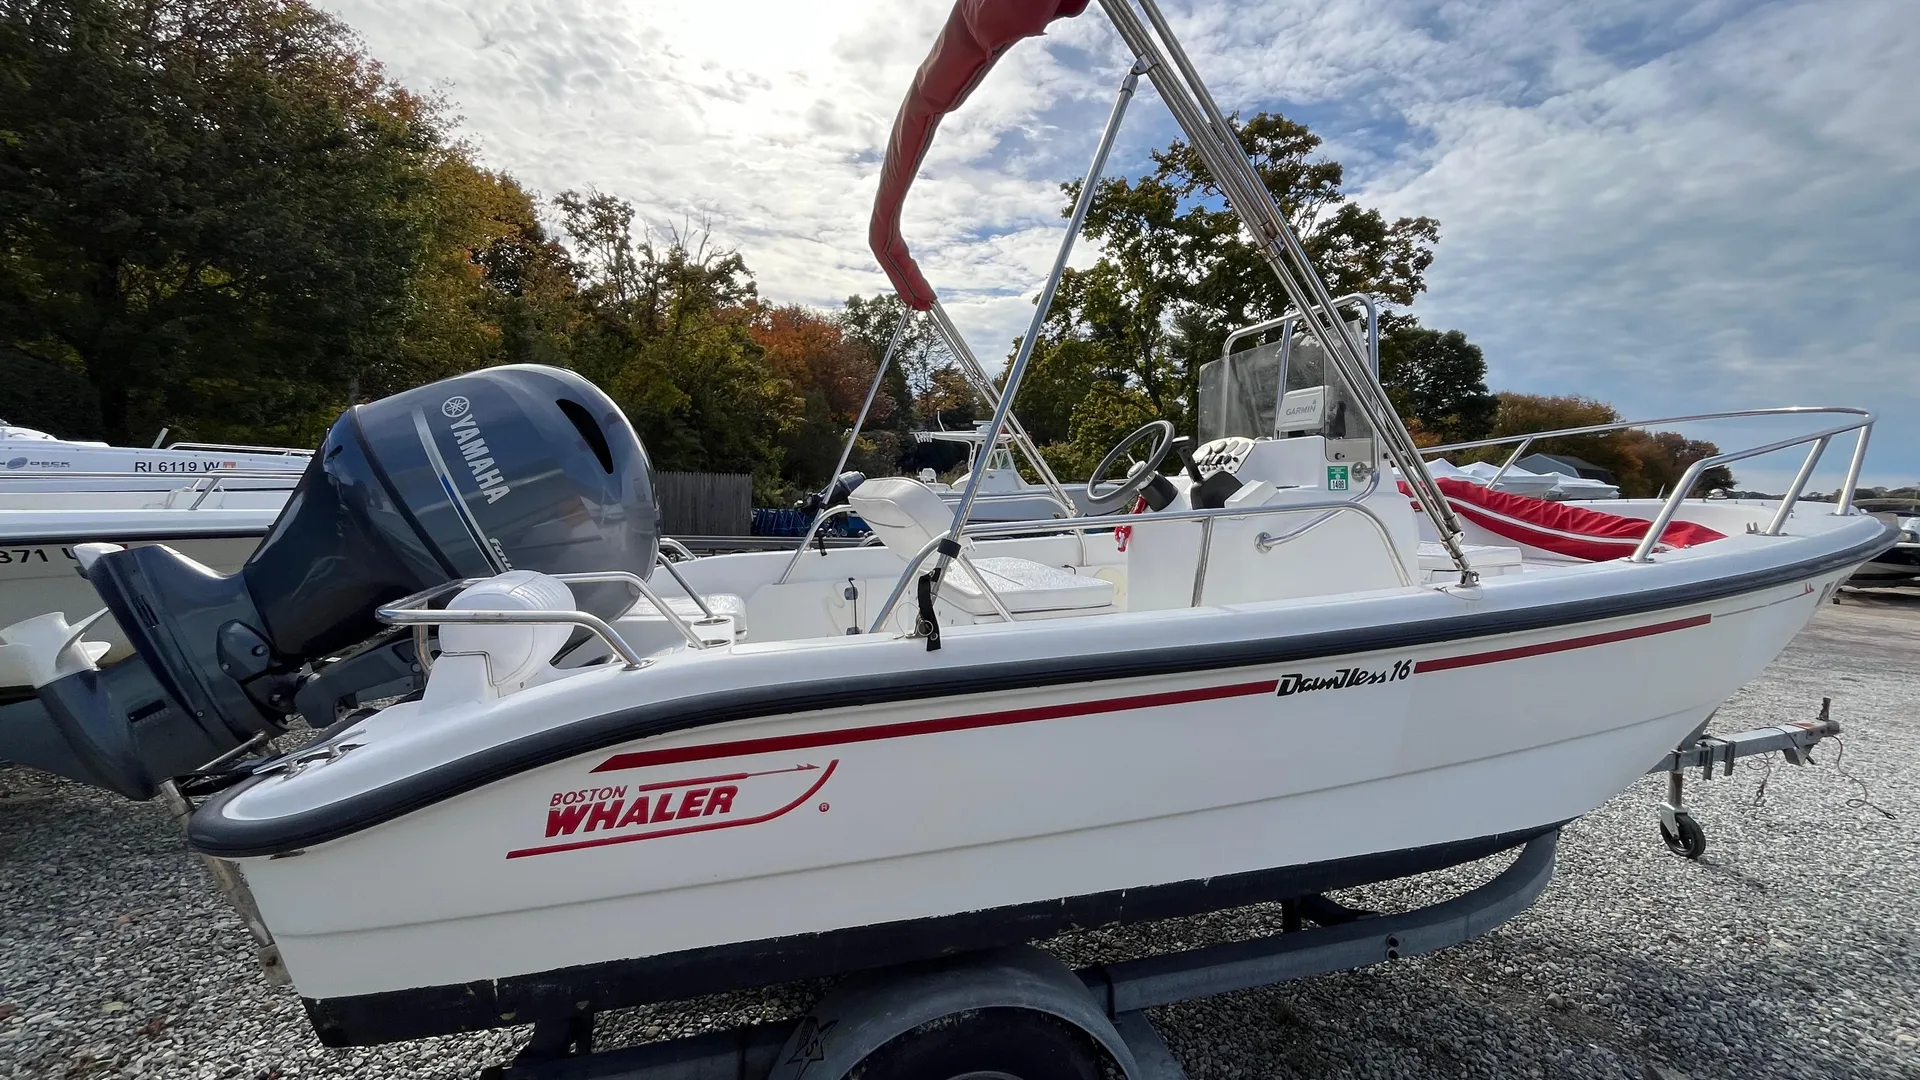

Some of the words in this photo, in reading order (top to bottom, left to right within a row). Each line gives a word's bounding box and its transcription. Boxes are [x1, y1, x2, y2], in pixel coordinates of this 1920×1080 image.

[1286, 405, 1317, 416] GARMIN
[134, 461, 152, 473] RI
[158, 461, 197, 472] 6119
[203, 461, 220, 472] W
[451, 413, 511, 505] YAMAHA
[1277, 668, 1387, 697] Dauntless
[1389, 659, 1413, 682] 16
[550, 785, 628, 807] BOSTON
[545, 785, 739, 838] WHALER
